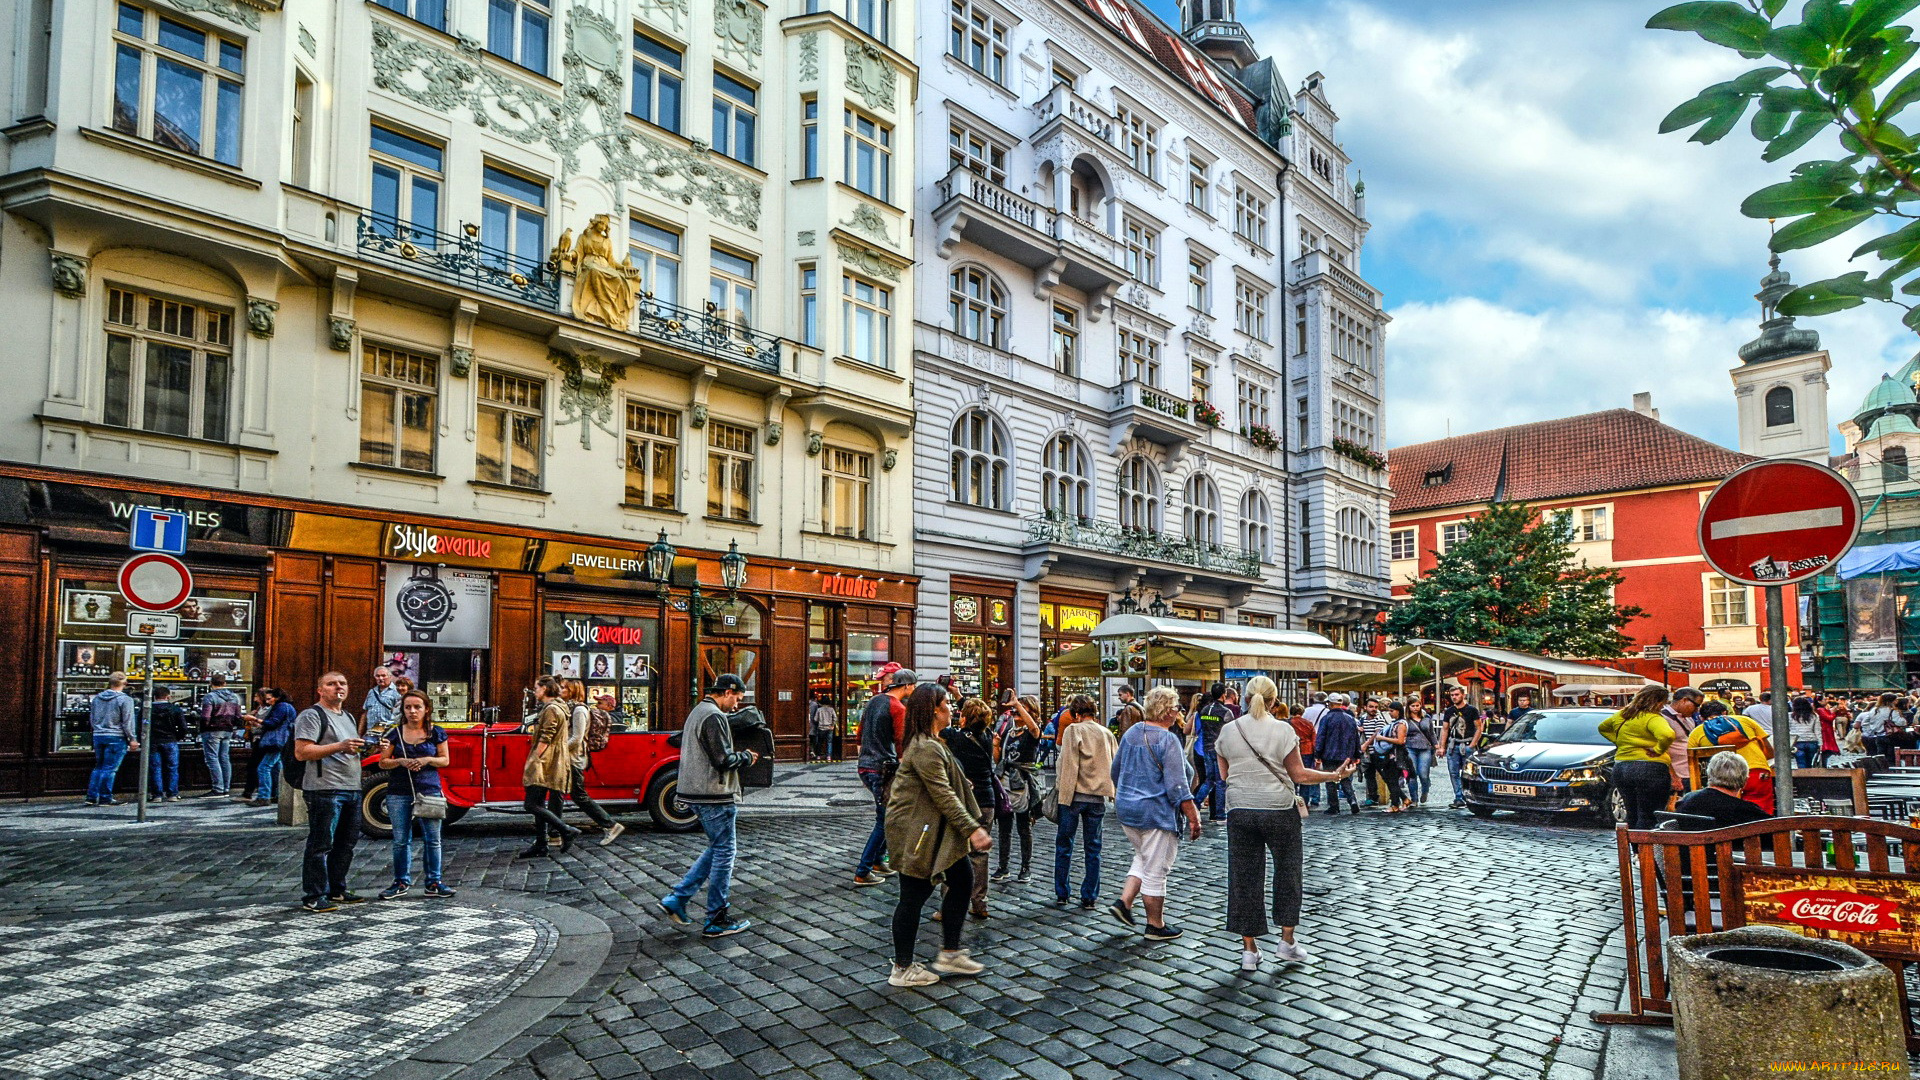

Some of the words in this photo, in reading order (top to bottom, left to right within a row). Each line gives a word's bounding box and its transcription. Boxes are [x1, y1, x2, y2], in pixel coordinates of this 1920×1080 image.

[109, 500, 220, 528] WHES
[393, 524, 490, 558] Styleavenue
[568, 552, 645, 572] JEWELLERY
[821, 575, 878, 599] PYLONES
[1061, 608, 1099, 626] MARKET
[563, 619, 643, 647] Styleavenue
[1494, 784, 1508, 793] 5AR
[1512, 785, 1532, 794] 5141
[1791, 897, 1881, 925] Coca-Cola
